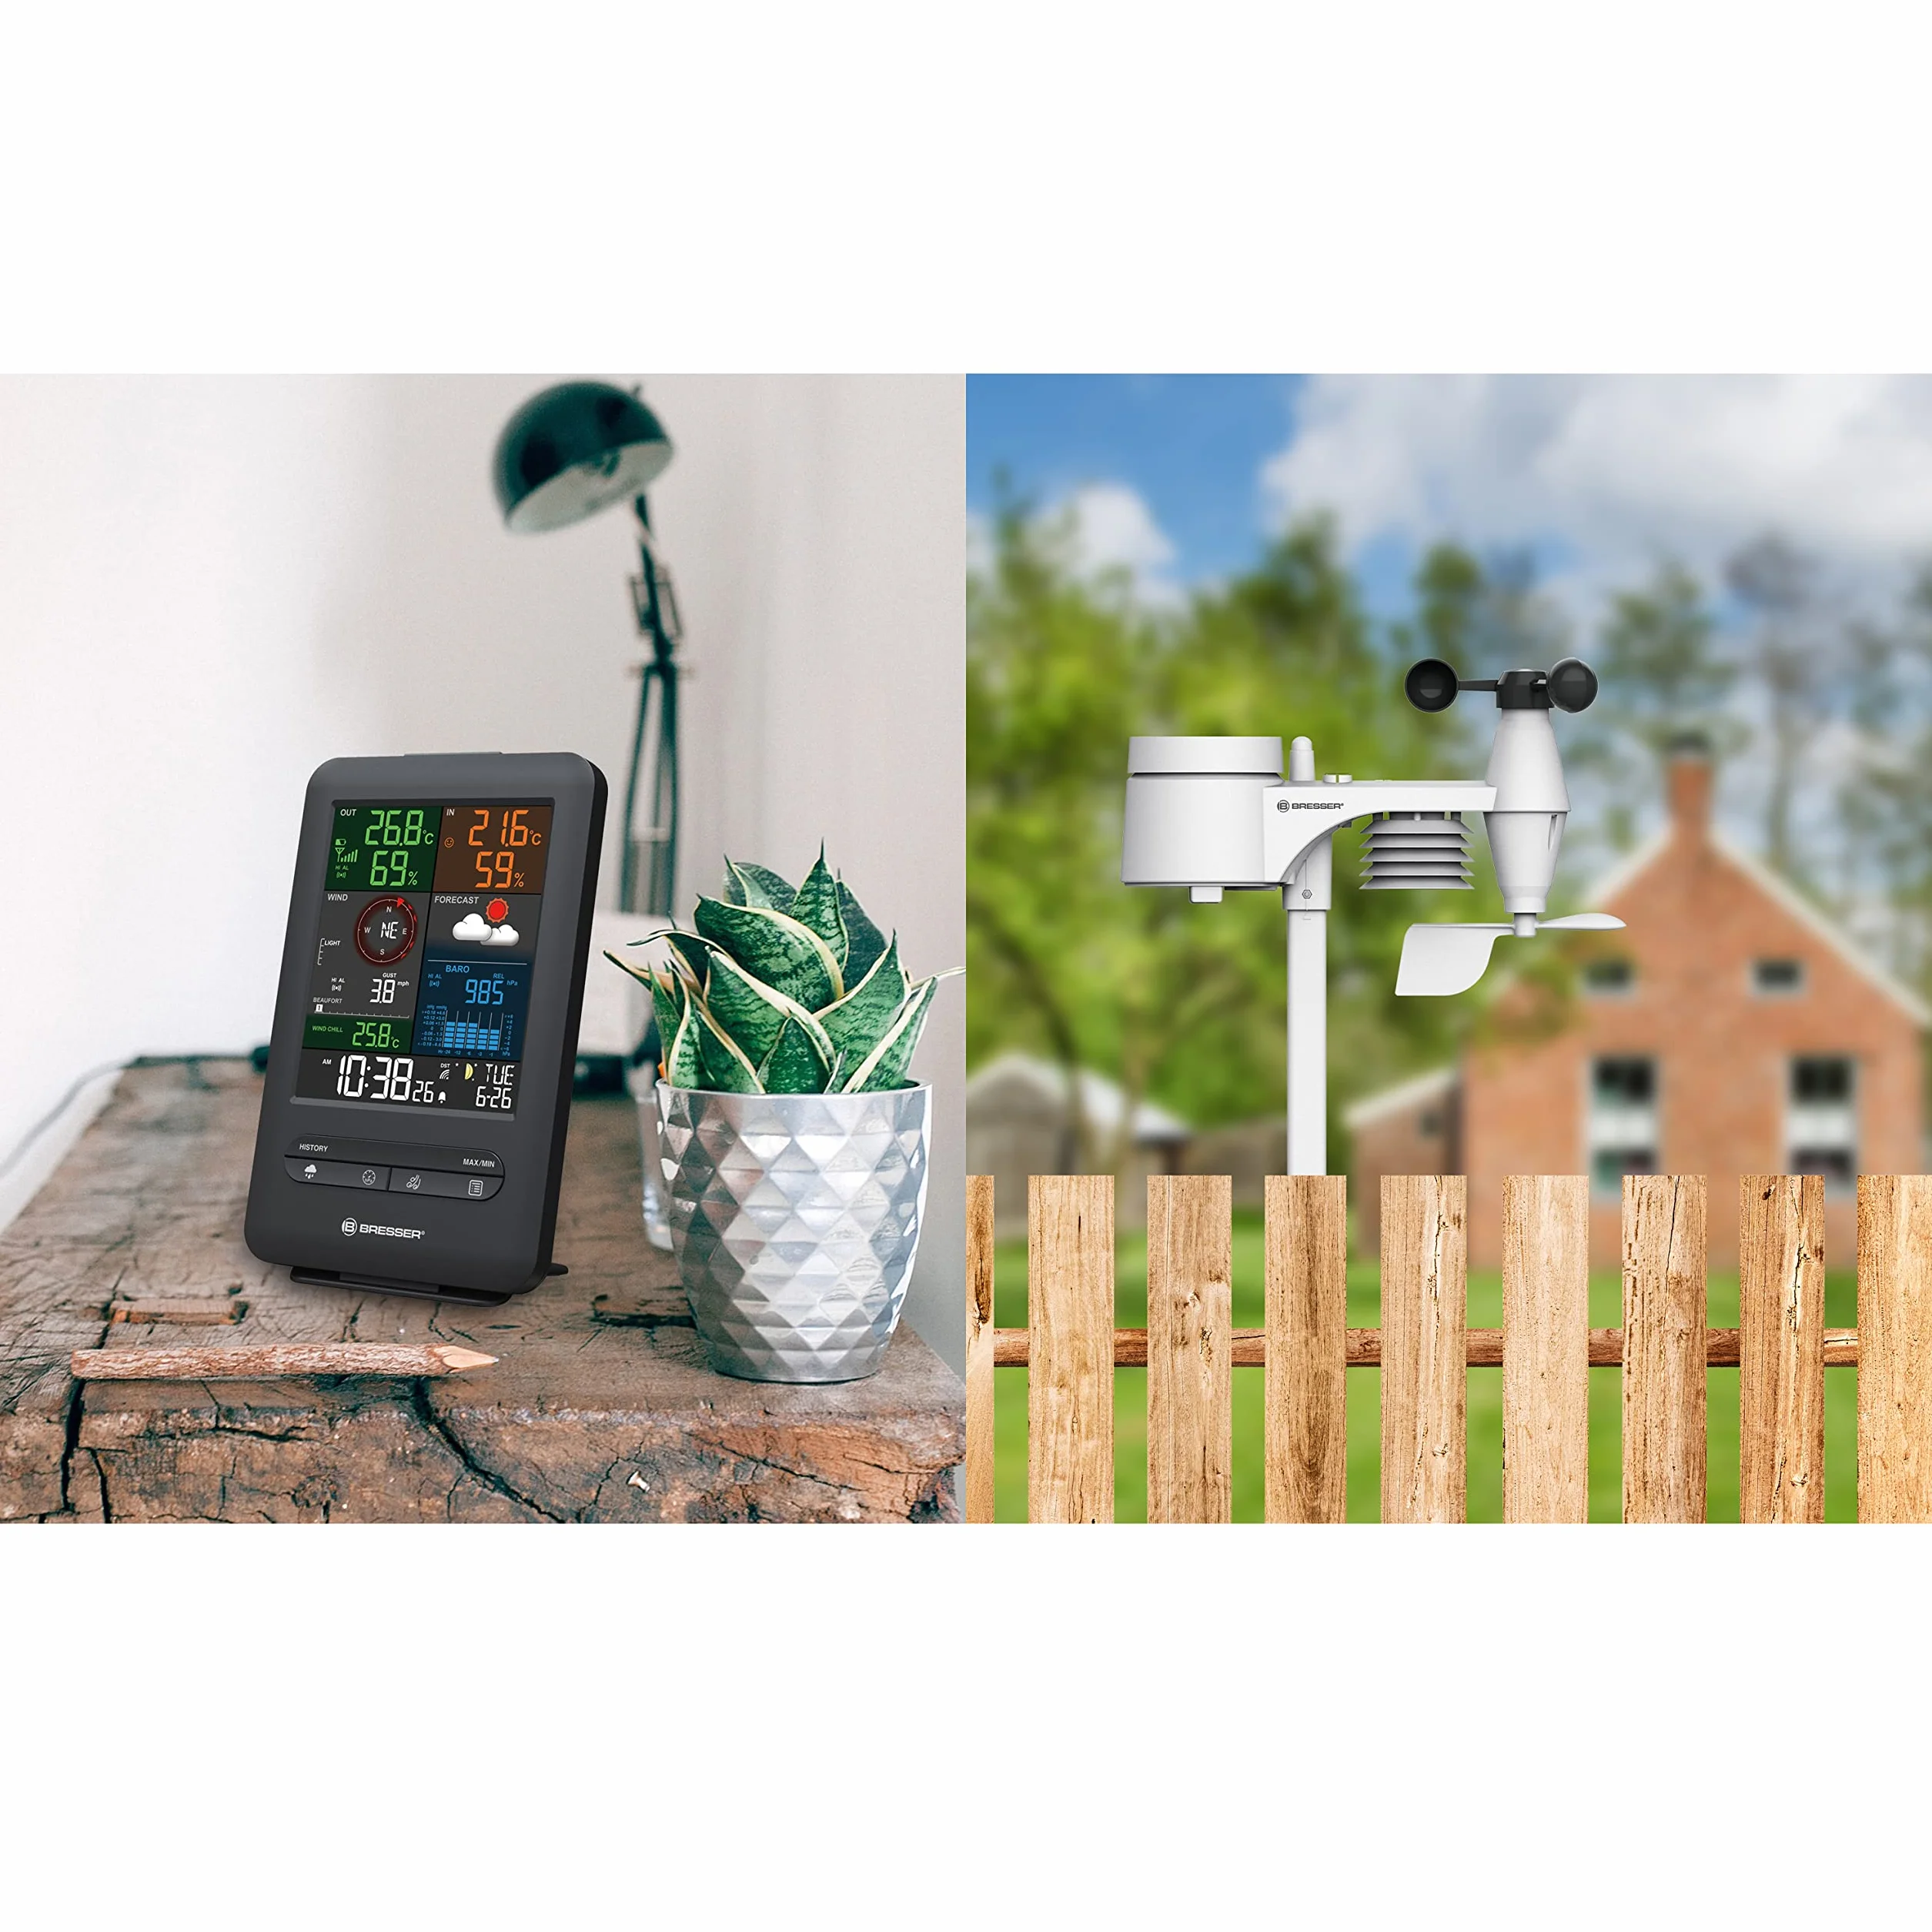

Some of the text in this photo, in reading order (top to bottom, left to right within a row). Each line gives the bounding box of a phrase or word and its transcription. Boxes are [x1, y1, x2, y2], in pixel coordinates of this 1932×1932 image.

[434, 895, 479, 904] FORECAST
[380, 921, 399, 939] NE
[446, 964, 470, 973] BARO
[465, 979, 503, 1005] 985
[336, 1055, 434, 1104] 10:38 26
[486, 1063, 515, 1086] TUE
[475, 1085, 512, 1109] 6-26
[299, 1143, 328, 1152] HISTORY
[463, 1158, 495, 1168] MAX/MIN
